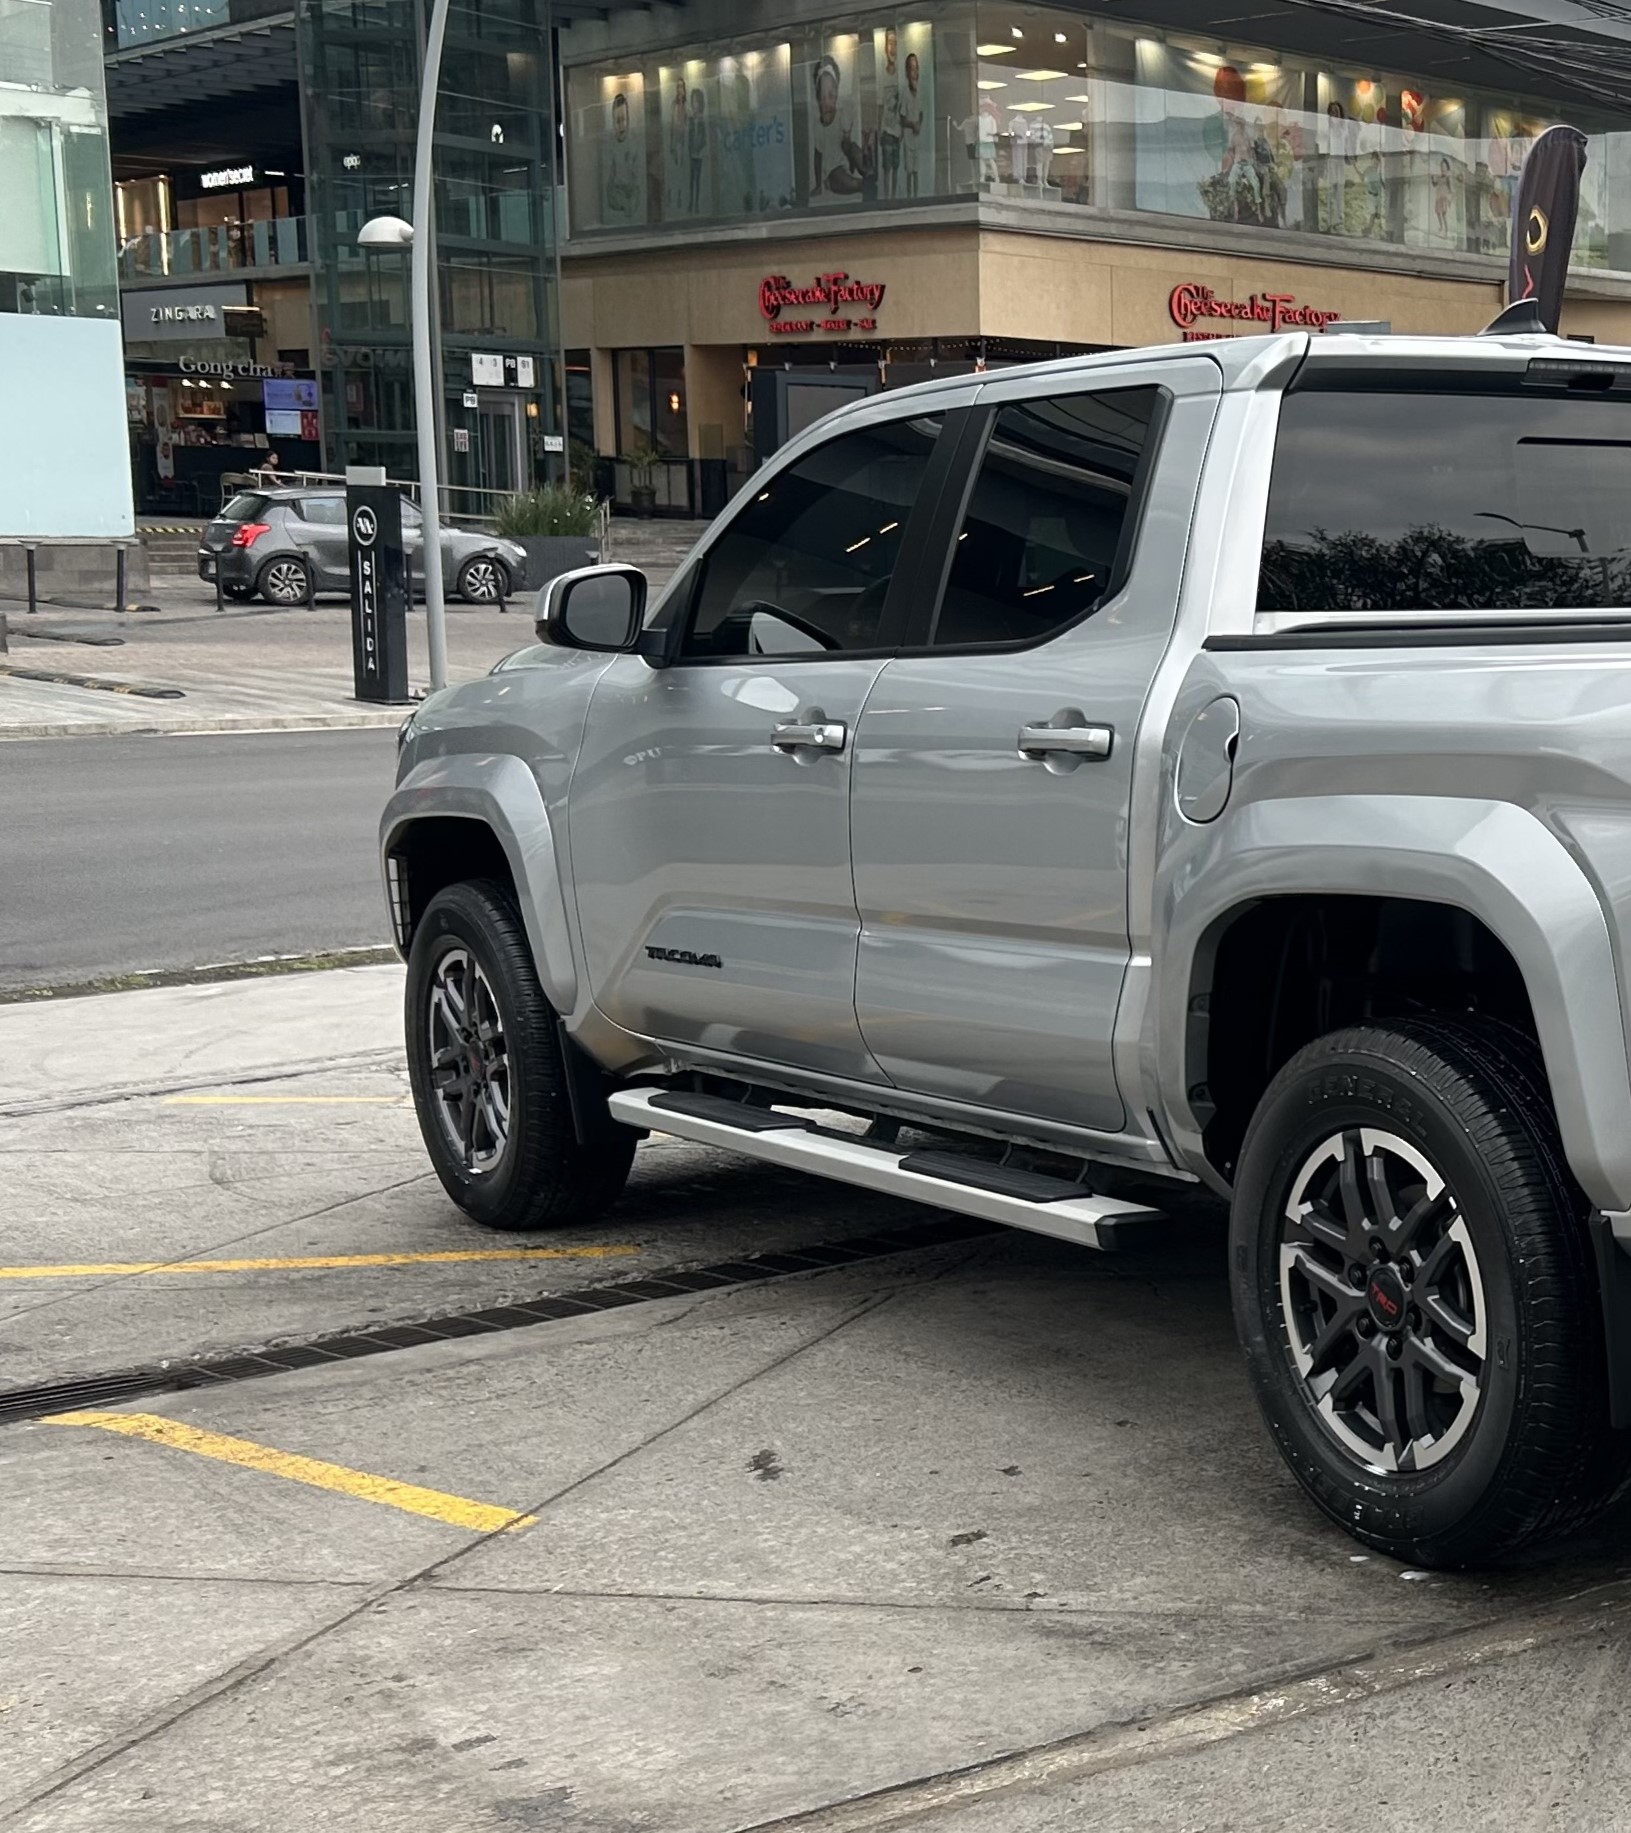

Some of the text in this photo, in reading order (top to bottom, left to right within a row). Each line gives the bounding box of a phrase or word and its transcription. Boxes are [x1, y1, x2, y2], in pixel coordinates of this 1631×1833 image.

[151, 305, 216, 322] ZINGARA
[1169, 284, 1272, 328] Cheesecake
[179, 355, 234, 379] Gong
[238, 359, 274, 378] cha
[362, 561, 376, 671] SALIDA
